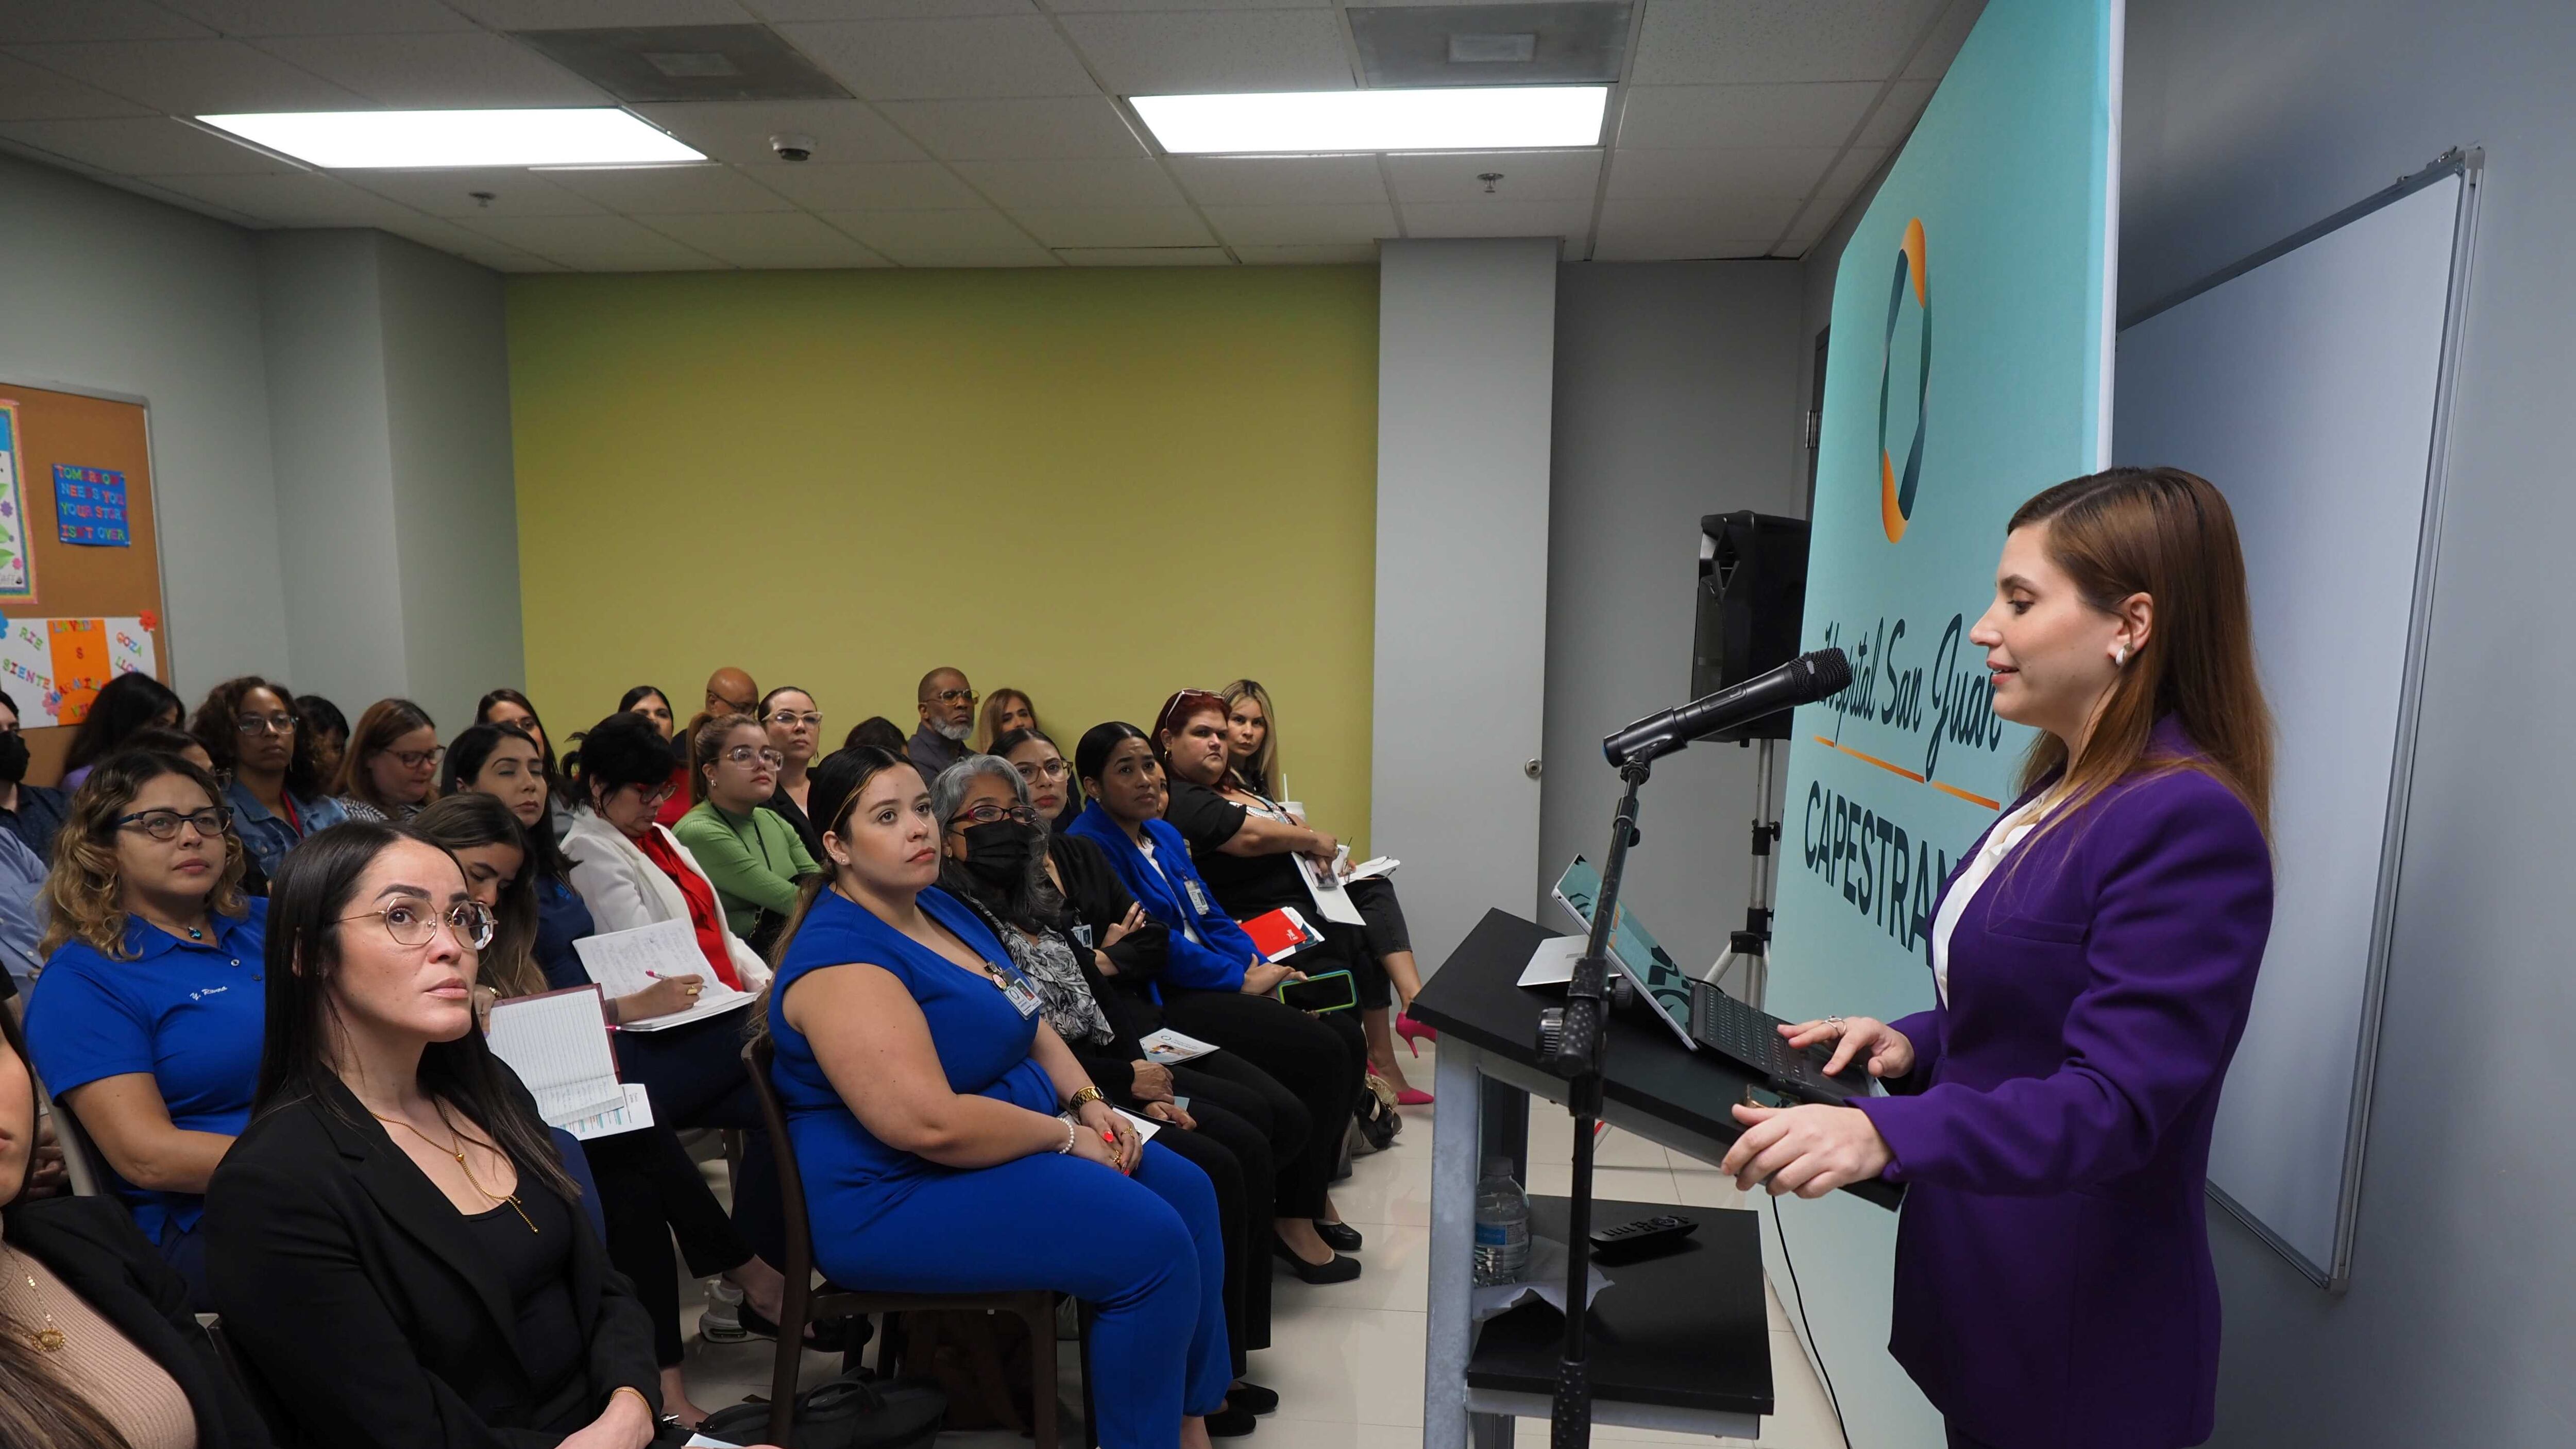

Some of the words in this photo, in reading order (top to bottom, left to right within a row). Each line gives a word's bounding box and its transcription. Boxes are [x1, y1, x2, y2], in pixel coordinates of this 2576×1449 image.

[61, 483, 99, 500] NEEDS
[61, 502, 92, 518] YOUR
[98, 526, 125, 541] OVER
[19, 627, 43, 651] RIE
[3, 658, 51, 690] SIENTE
[1882, 618, 1922, 733] San
[1926, 613, 2002, 782] Juan
